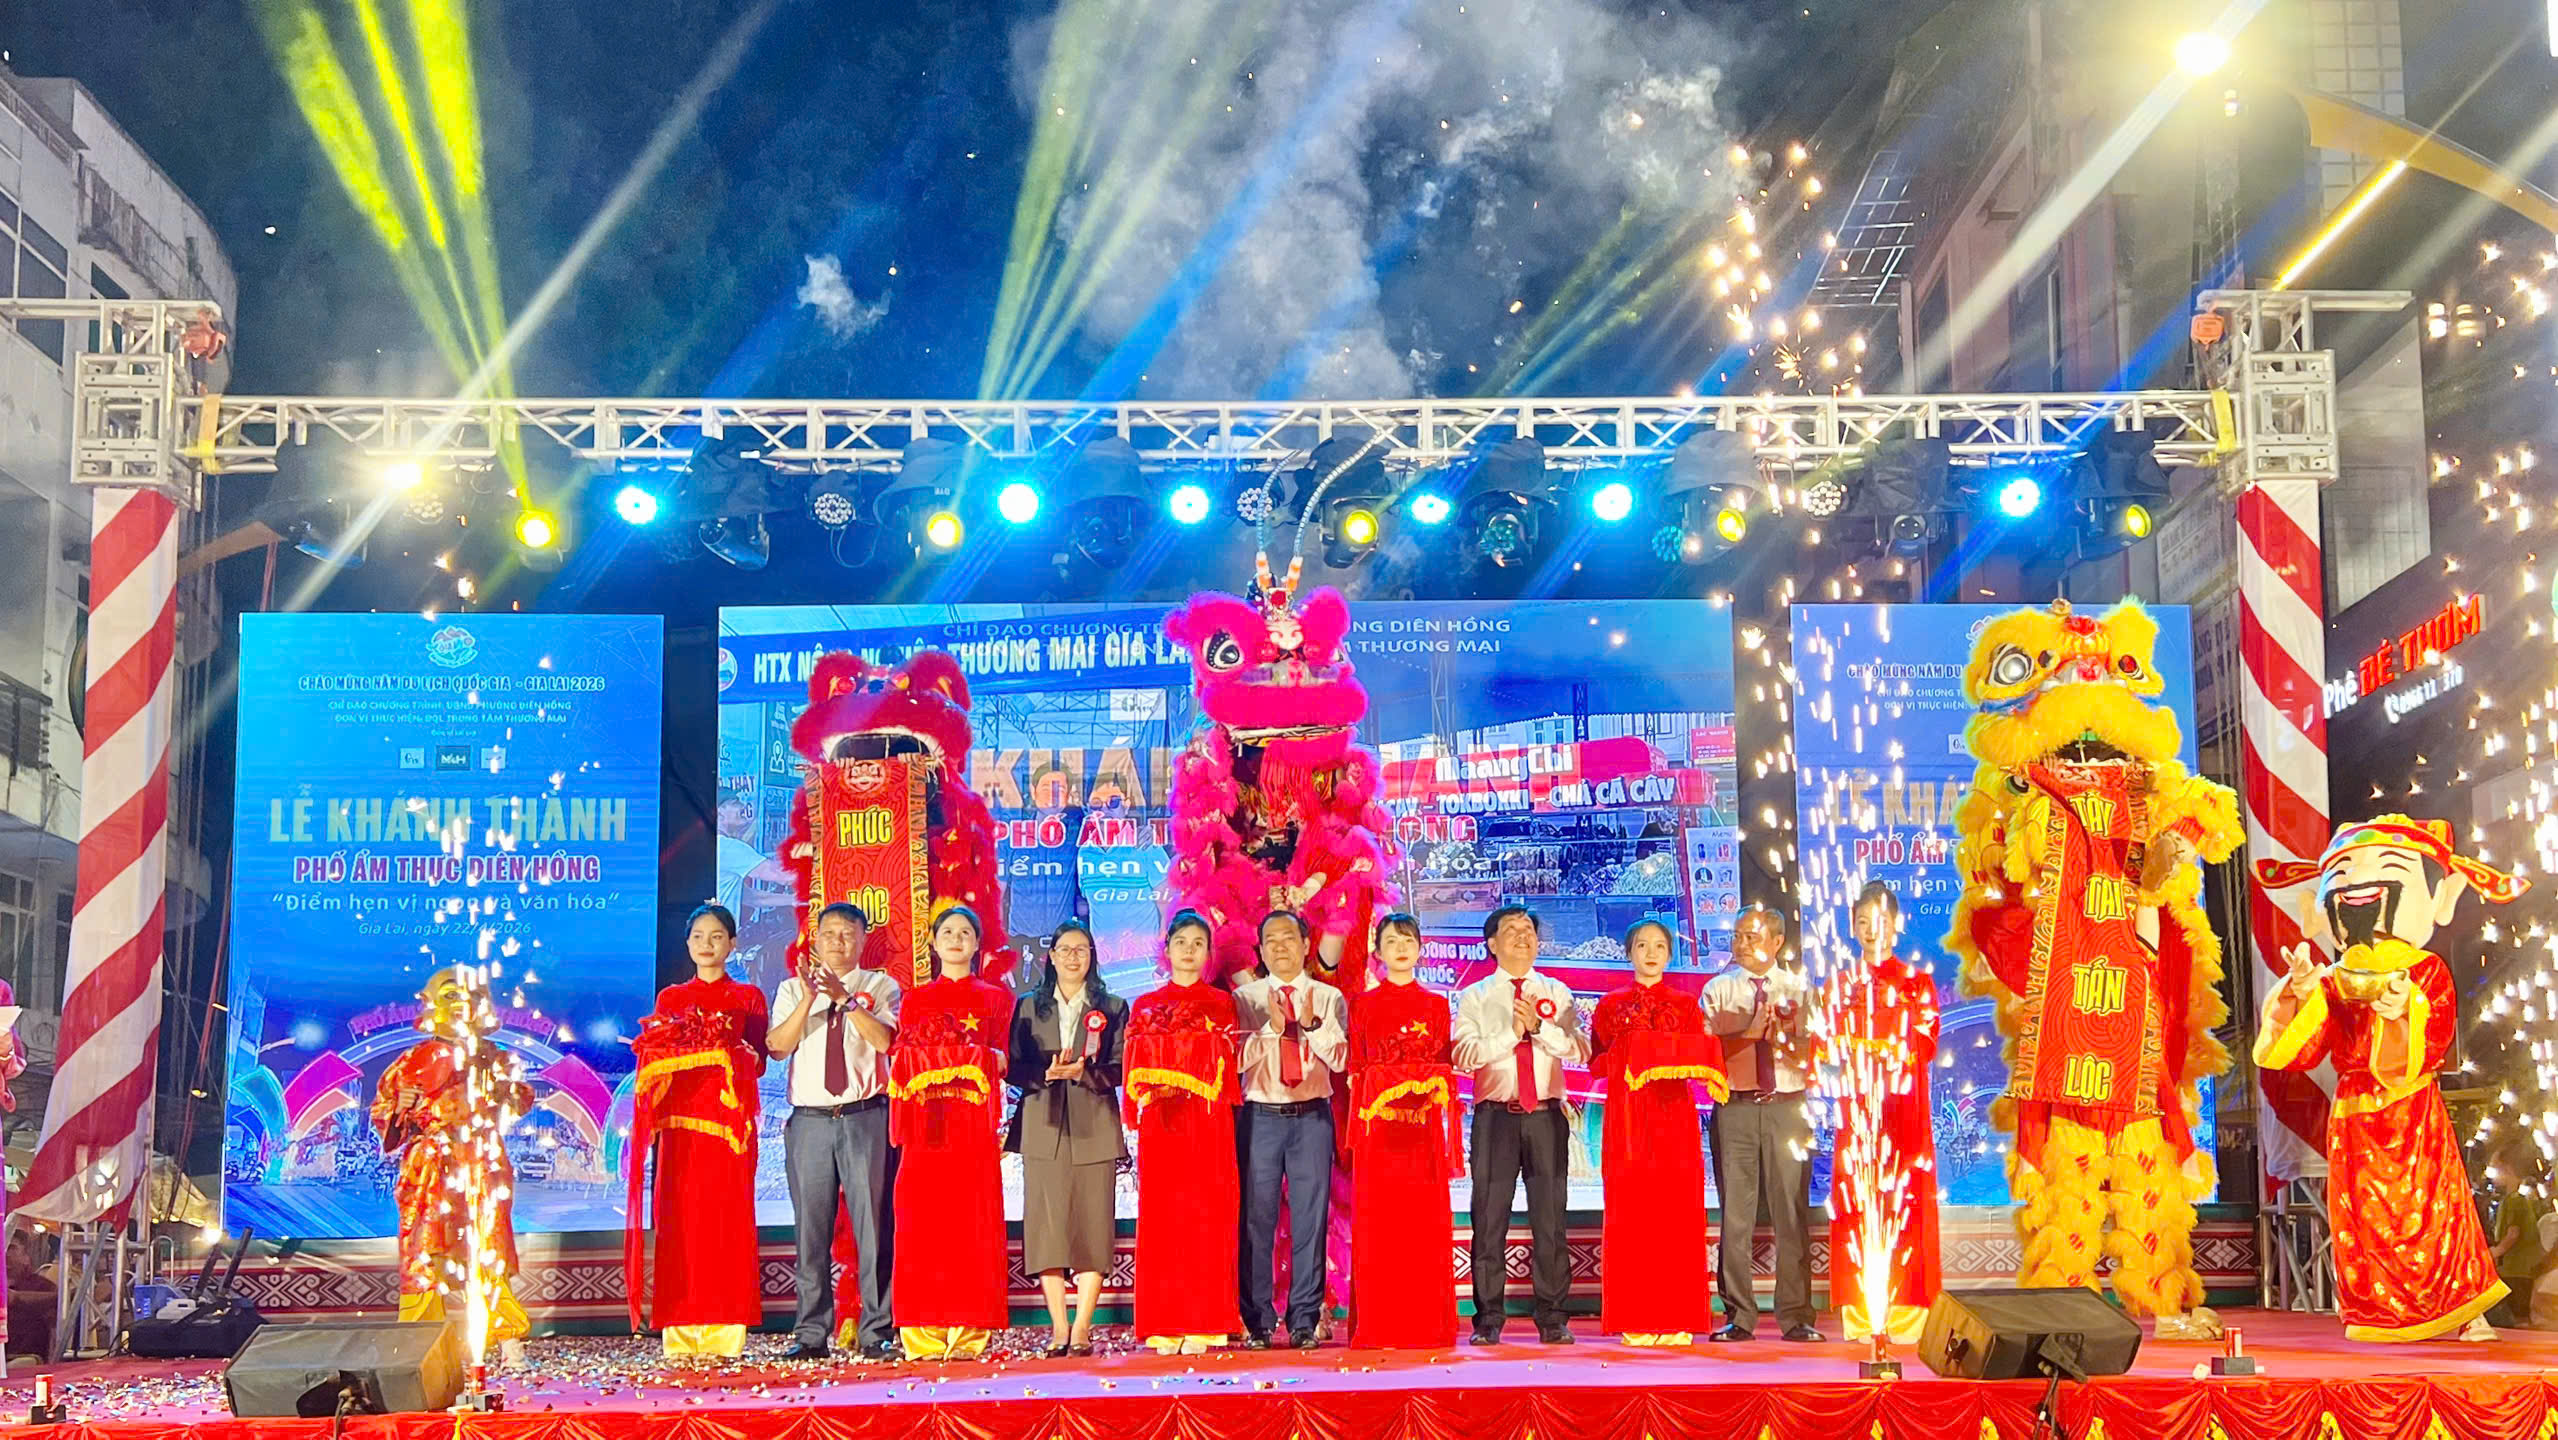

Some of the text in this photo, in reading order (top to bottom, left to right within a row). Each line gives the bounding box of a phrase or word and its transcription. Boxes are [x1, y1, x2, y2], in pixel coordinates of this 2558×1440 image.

[1390, 618, 1440, 633] DIÊN
[1447, 616, 1511, 633] HỒNG
[754, 652, 792, 684] HTX
[1049, 635, 1096, 677] MẠI
[1104, 631, 1147, 668] GIA
[1156, 632, 1192, 665] LA
[1358, 640, 1450, 653] THƯƠNG
[1457, 640, 1501, 655] MẠI
[1944, 664, 1964, 678] DU
[372, 673, 401, 691] NĂM
[402, 676, 420, 690] DU
[422, 675, 450, 692] LỊCH
[453, 673, 487, 693] QUỐC
[488, 675, 511, 691] GIA
[524, 675, 547, 691] GIA
[549, 675, 569, 691] LAI
[570, 675, 605, 691] 2026
[2323, 670, 2358, 719] Phê
[1436, 789, 1530, 815] TOKBOKKI
[1595, 776, 1627, 805] CÁ
[1629, 775, 1676, 803] CÂY
[270, 783, 627, 842] LỄ KHÁNH THÀNH
[837, 805, 894, 848] PHÚC
[994, 812, 1067, 849] PHỐ
[1076, 811, 1138, 848] ẨM
[1854, 832, 1905, 864] PHỐ
[294, 849, 601, 888] PHỐ ẨM THỰC DIÊN HỒNG
[999, 856, 1063, 876] iểm
[1078, 856, 1141, 881] hẹn
[349, 893, 389, 913] hẹn
[396, 893, 417, 913] vị
[520, 894, 559, 910] văn
[1094, 889, 1174, 904] Gia Lai,
[1920, 903, 1942, 915] Gia
[359, 922, 382, 935] Gia
[1458, 940, 1488, 961] PHỐ
[1419, 963, 1456, 983] QUỐC
[2064, 1053, 2112, 1105] LỘC
